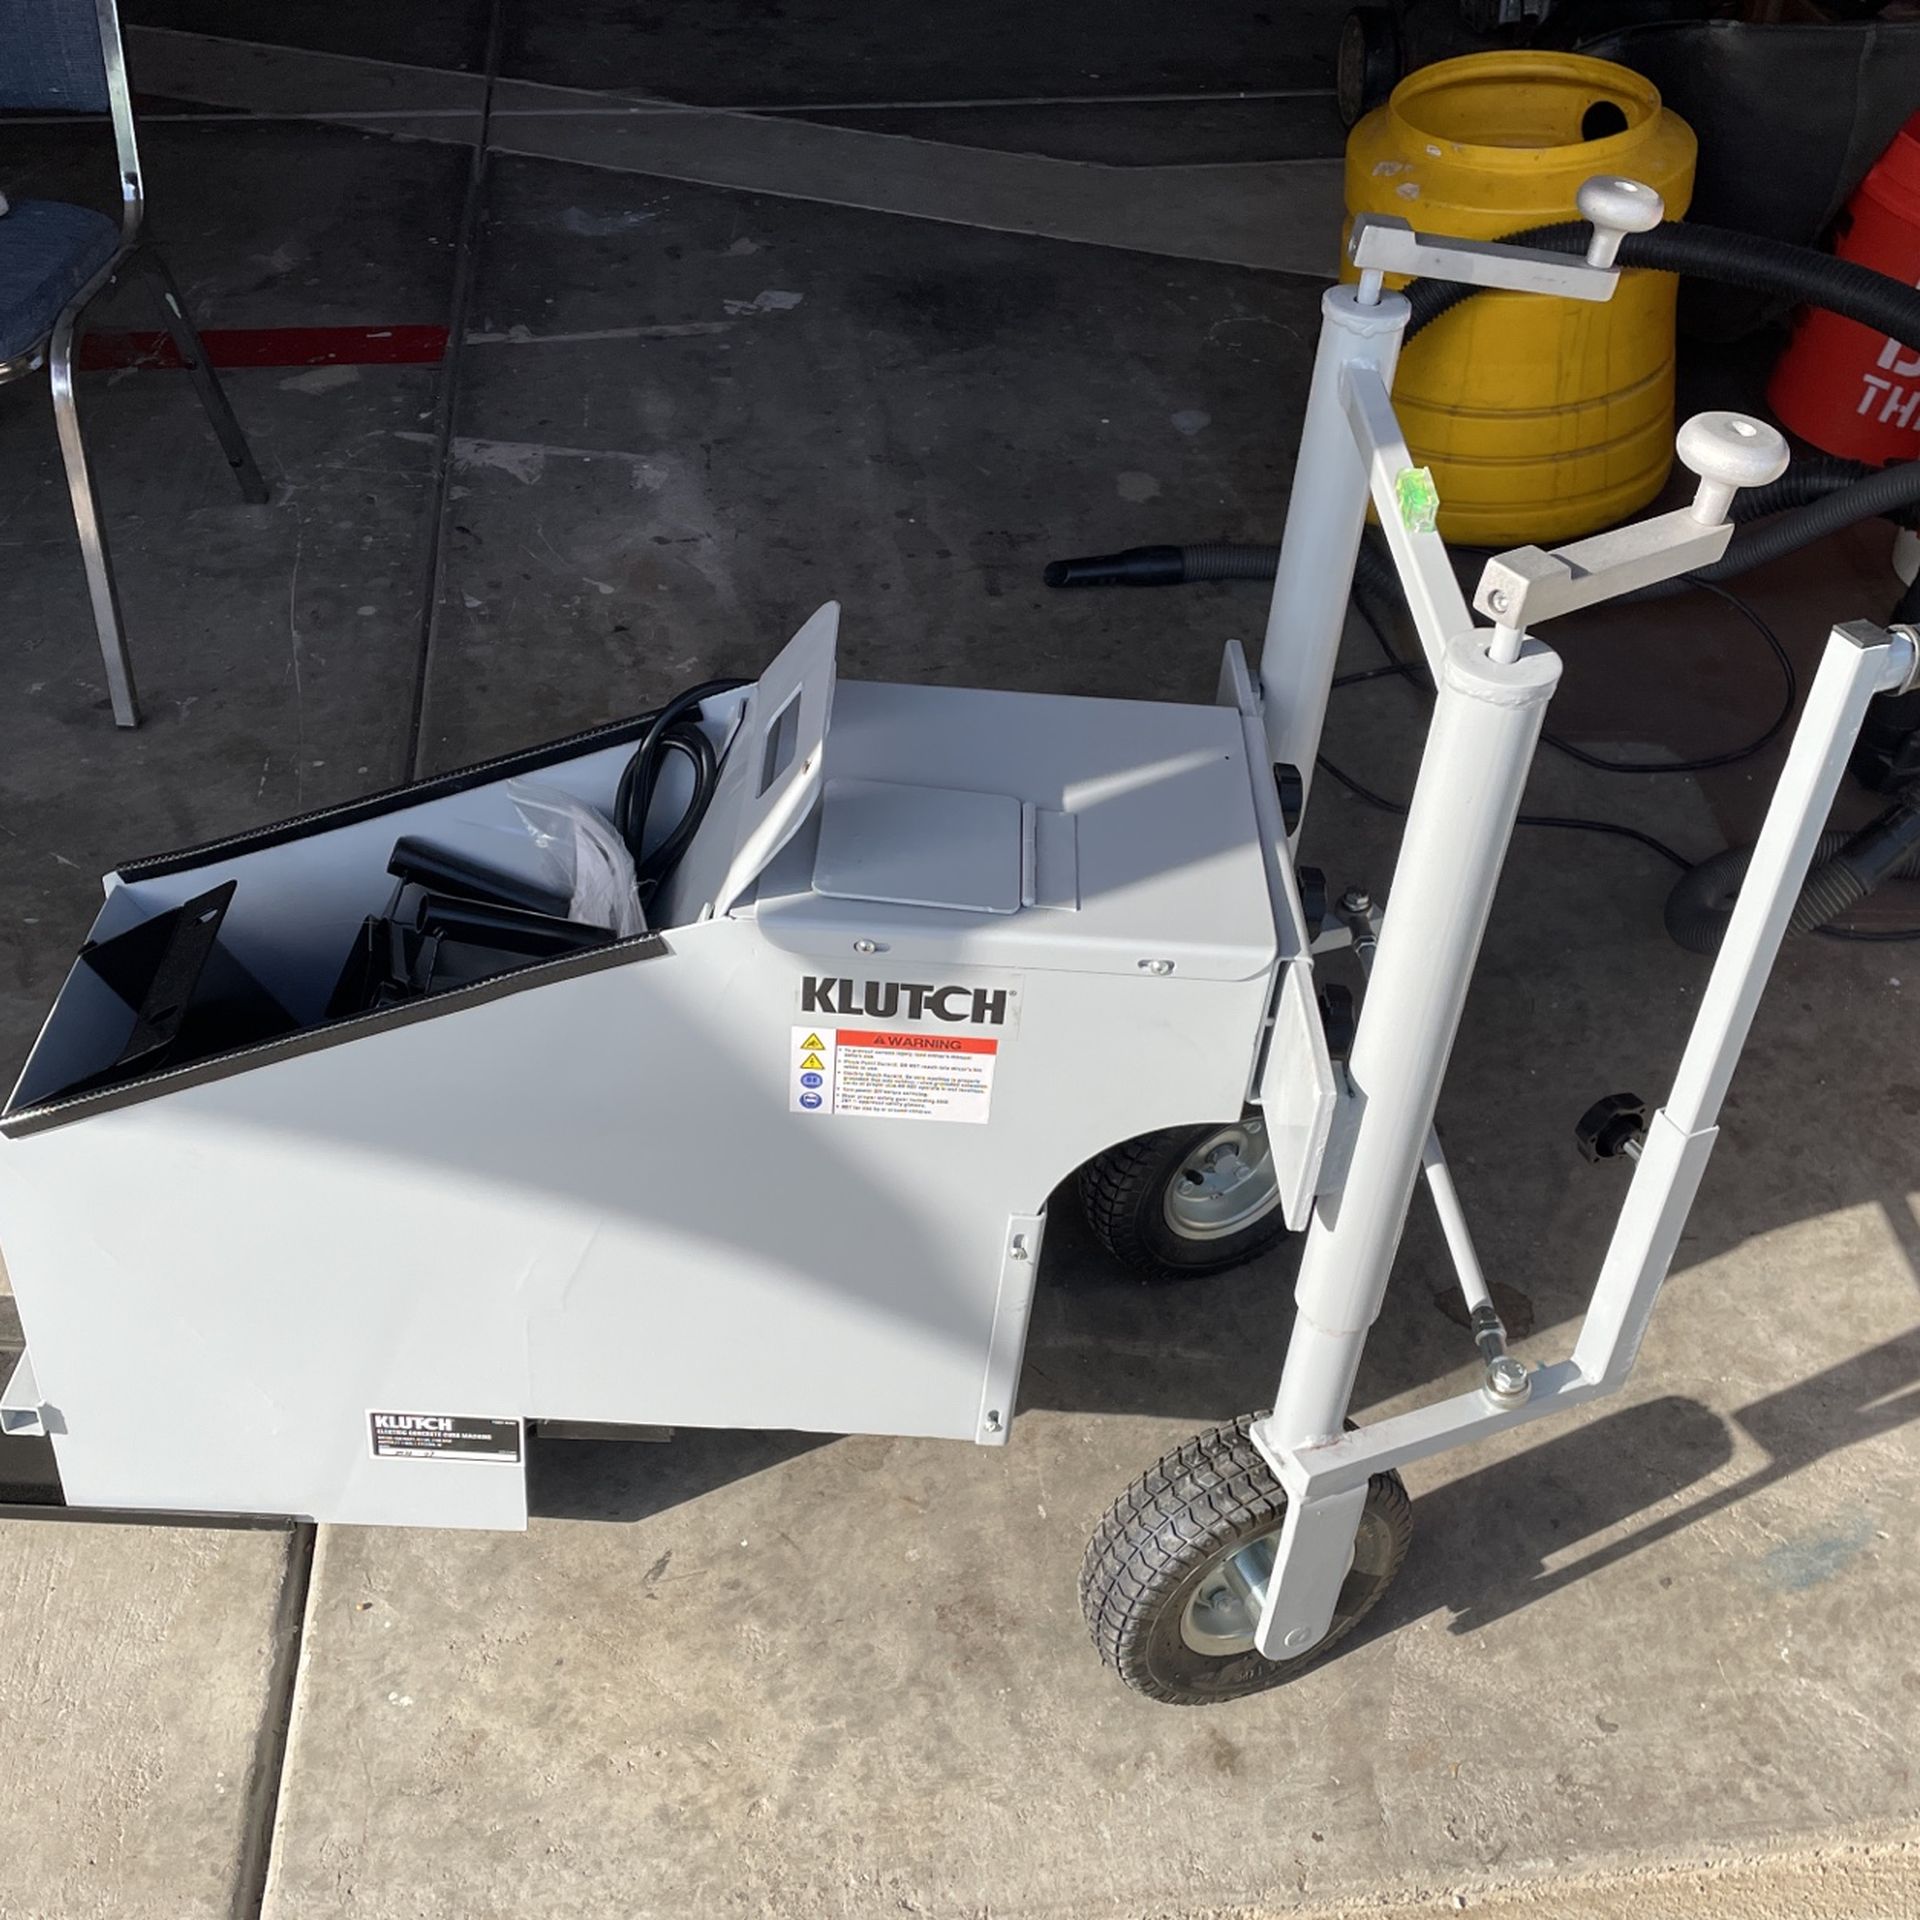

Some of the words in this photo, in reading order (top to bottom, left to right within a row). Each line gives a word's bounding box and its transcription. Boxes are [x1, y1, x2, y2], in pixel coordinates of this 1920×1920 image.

[801, 975, 1007, 1025] KLUTCH
[887, 1036, 962, 1050] WARNING
[375, 1415, 452, 1431] KLUTCH
